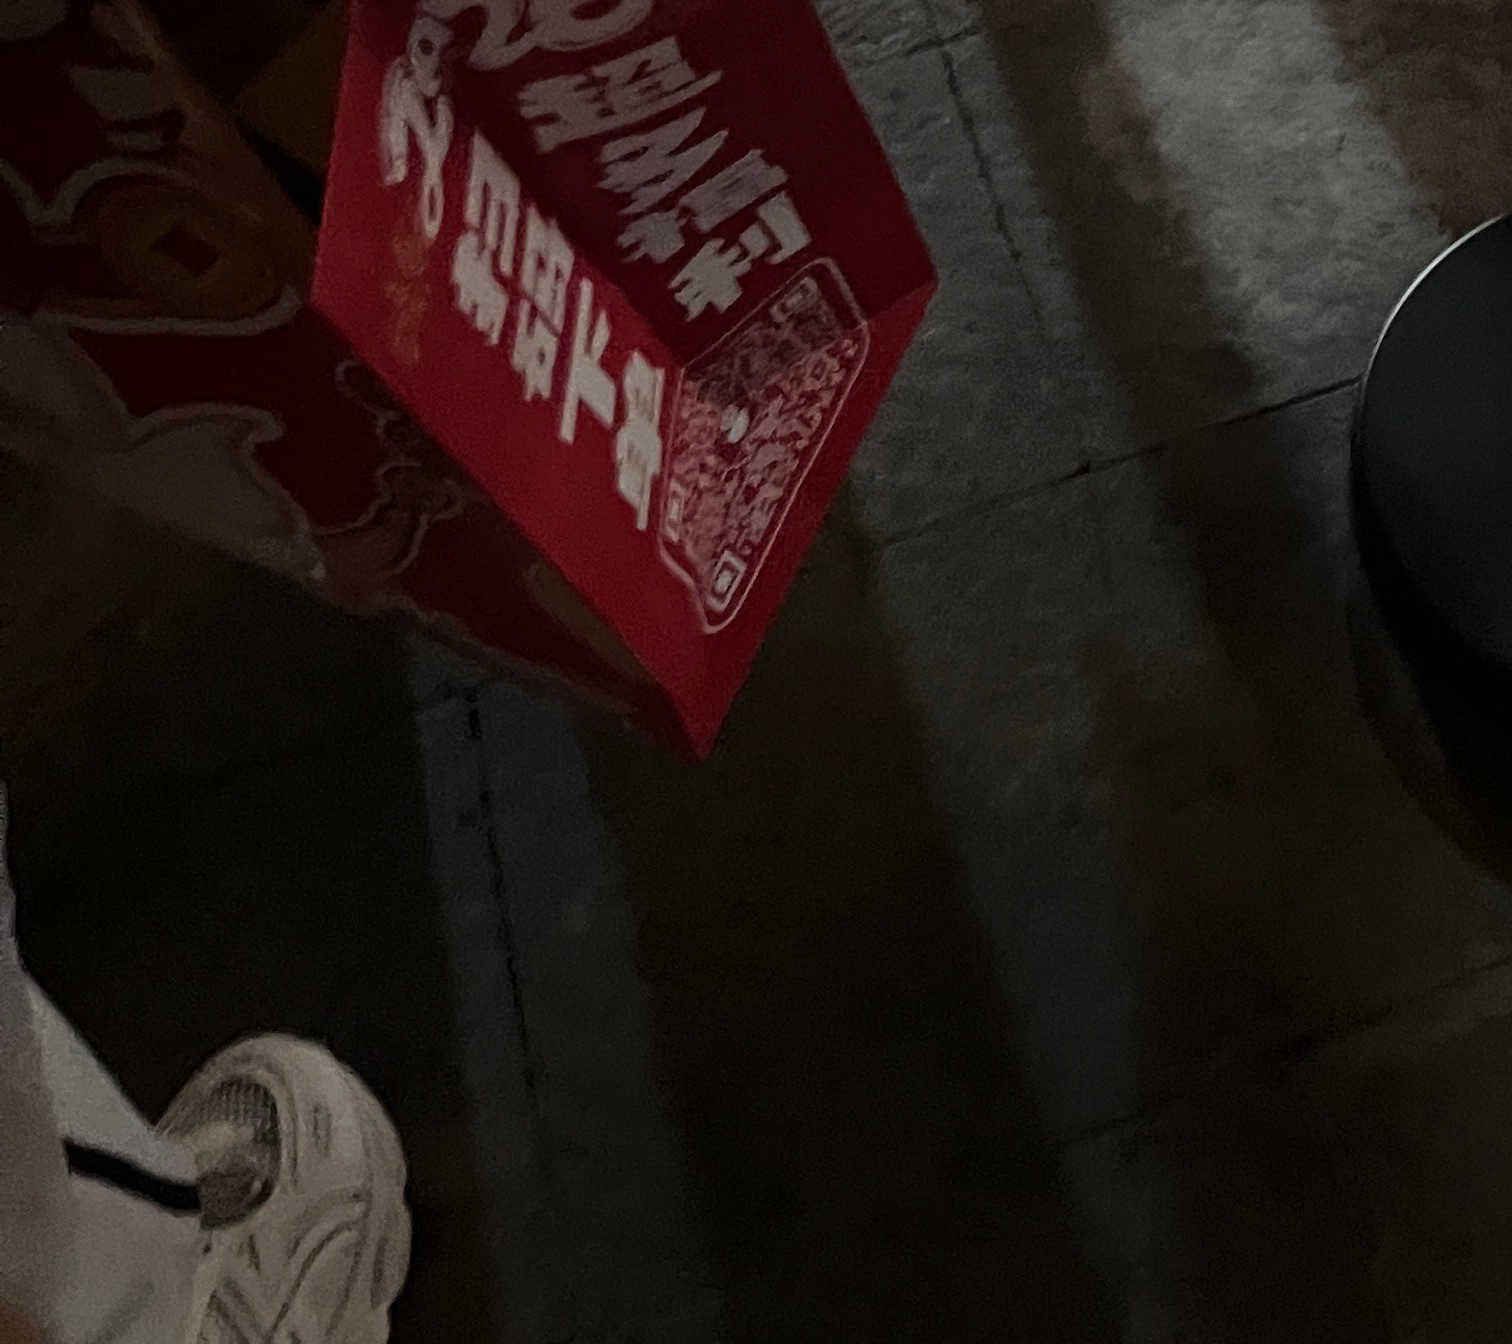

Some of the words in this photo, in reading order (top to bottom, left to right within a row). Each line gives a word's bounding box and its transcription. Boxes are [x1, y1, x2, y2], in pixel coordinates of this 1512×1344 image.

[451, 129, 668, 532] 扫码下单
[516, 34, 812, 319] 超多福利
